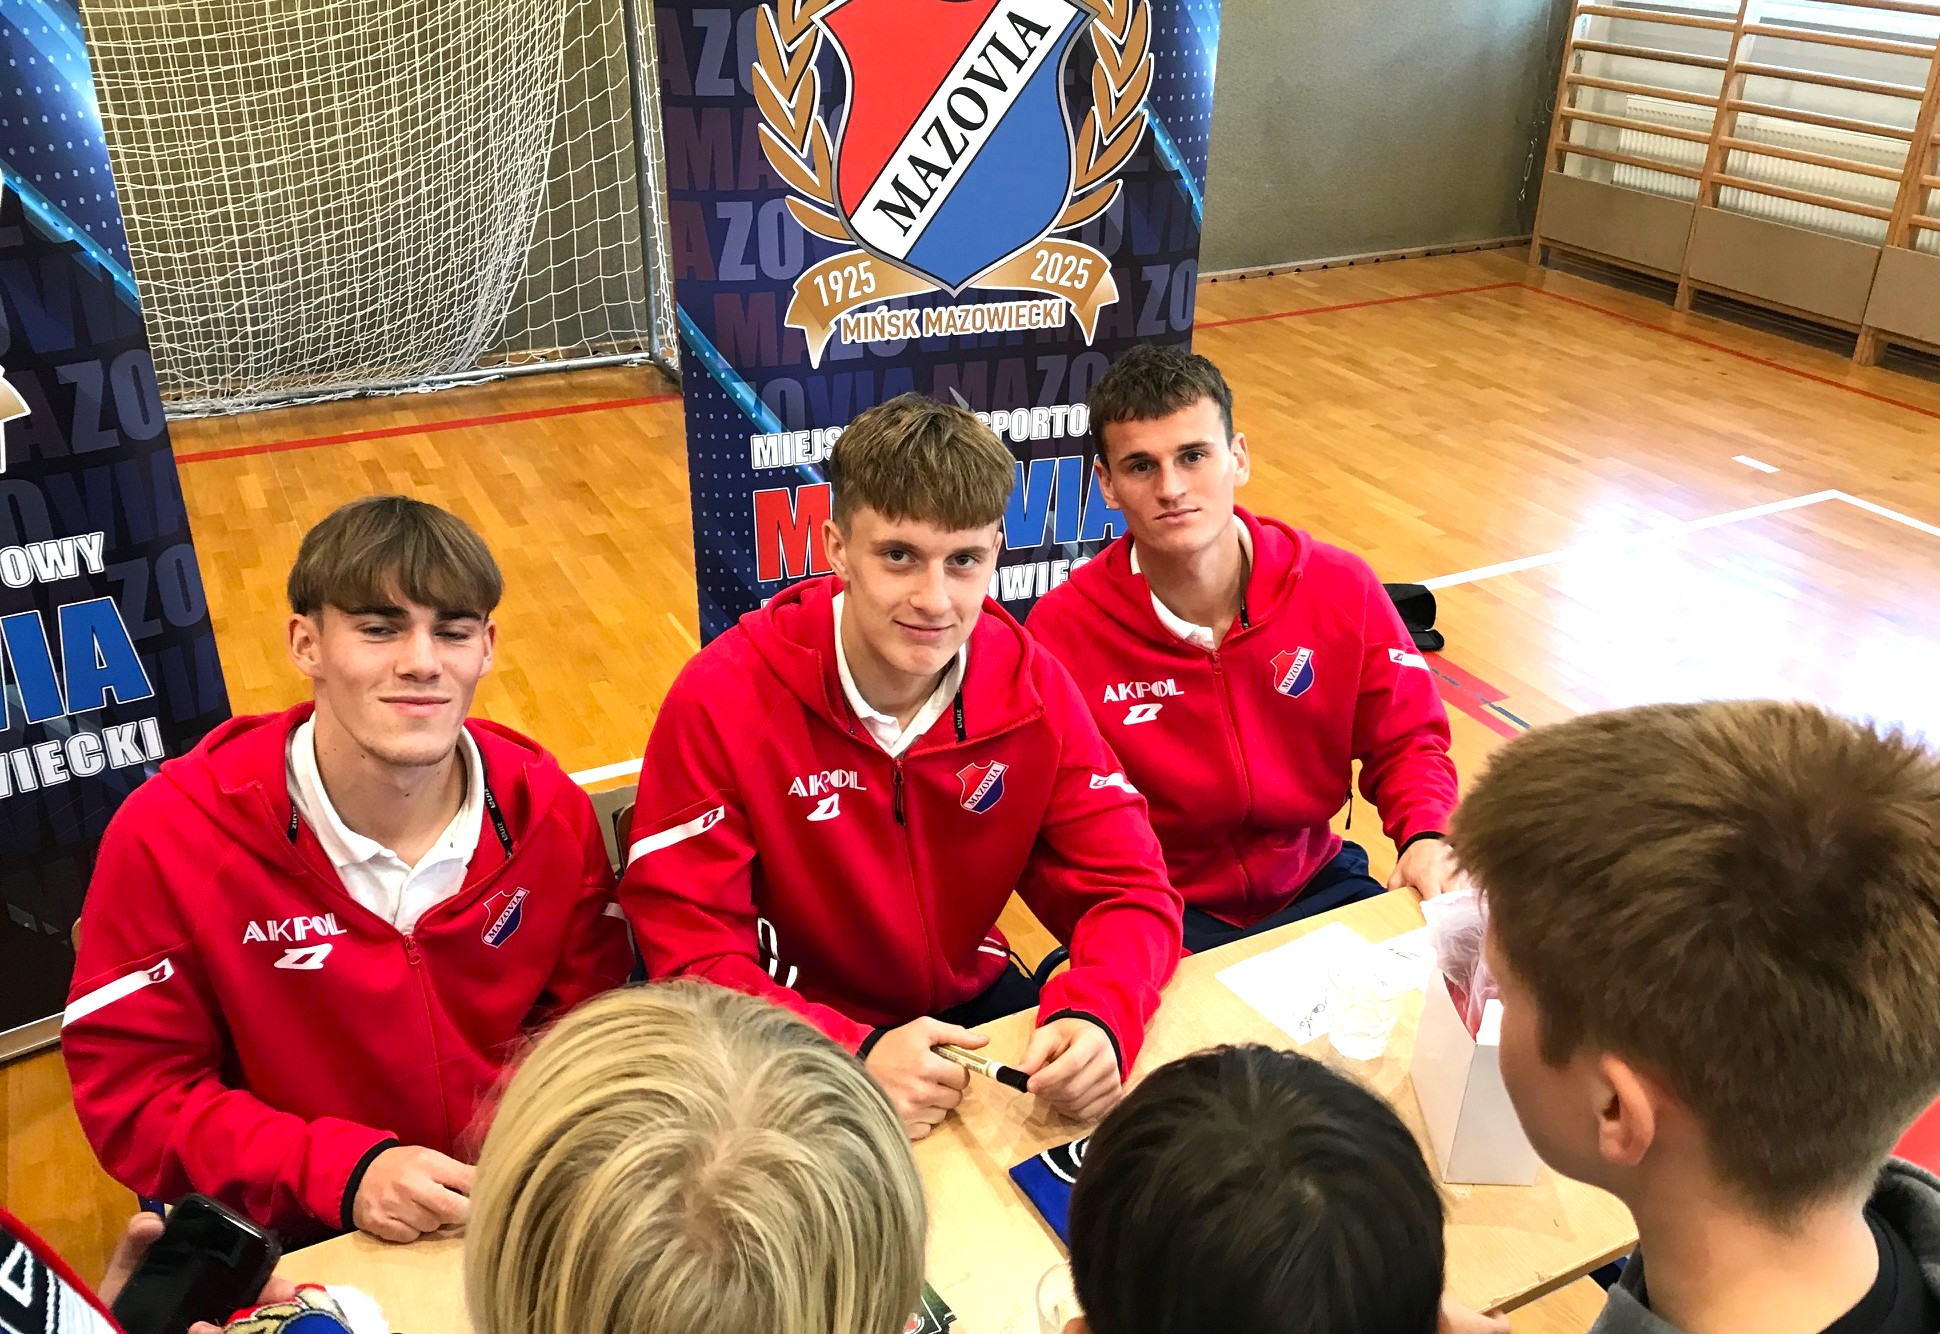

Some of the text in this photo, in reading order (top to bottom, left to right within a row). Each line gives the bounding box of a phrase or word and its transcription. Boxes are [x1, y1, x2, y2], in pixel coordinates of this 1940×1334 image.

[872, 8, 1051, 236] MAZOVIA
[812, 262, 877, 308] 1925
[1030, 251, 1093, 291] 2025
[841, 311, 919, 343] MIŃSK
[923, 302, 1066, 339] MAZOWIECKI
[752, 425, 850, 468] MIEJS
[1103, 678, 1184, 704] AKPOL
[1281, 654, 1306, 689] MAZOVIA
[788, 768, 867, 797] AKPOL
[967, 768, 1000, 806] MAZOVIA
[242, 912, 347, 945] AKPOL
[488, 895, 521, 939] MAZOVIA
